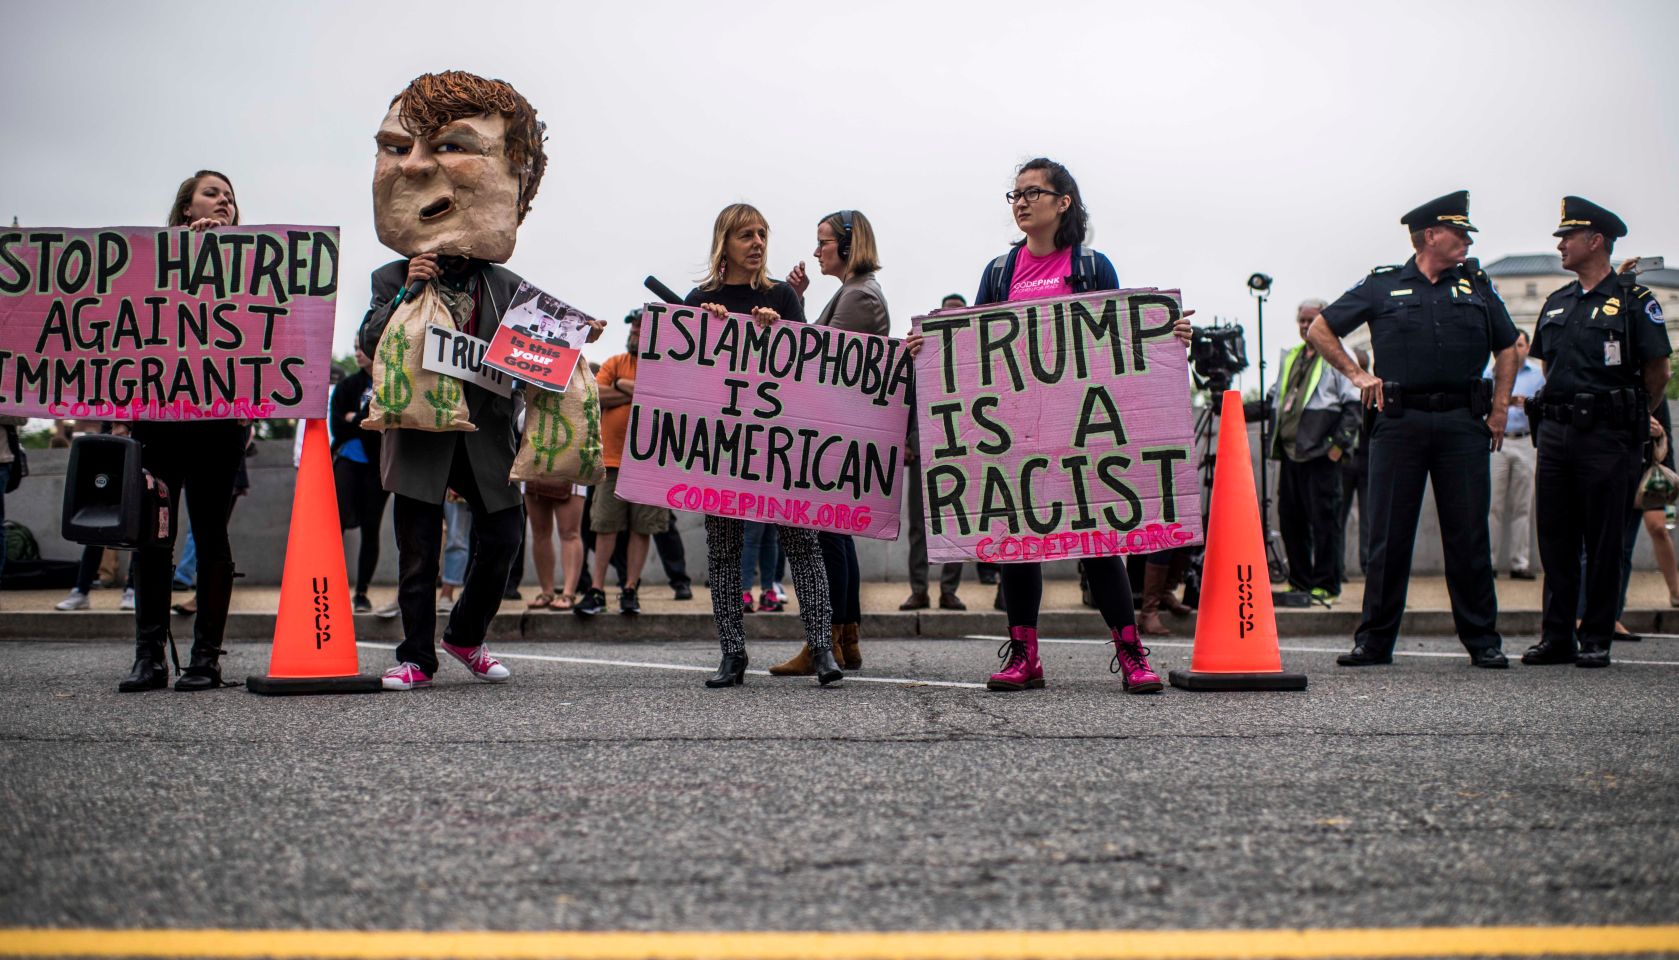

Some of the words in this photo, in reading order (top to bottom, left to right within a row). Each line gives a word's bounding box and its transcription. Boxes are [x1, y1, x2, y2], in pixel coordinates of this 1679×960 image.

[0, 231, 129, 295] STOP
[157, 230, 338, 304] HATRED
[1013, 277, 1060, 290] CODEPINK
[35, 297, 289, 354] AGAINST
[510, 335, 525, 349] Is
[528, 343, 561, 358] this
[921, 294, 1181, 393] TRUMP
[431, 327, 503, 384] TRU
[503, 356, 552, 376] GOP?
[510, 348, 554, 365] your
[641, 305, 914, 407] ISLAMOPHOBIA
[48, 397, 276, 421] CODEPINK.ORG
[721, 378, 783, 419] IS
[931, 396, 1011, 459] IS
[1074, 386, 1128, 448] A
[630, 405, 898, 500] UNAMERICAN
[666, 483, 872, 532] CODEPINK.ORG
[926, 449, 1187, 535] RACIST
[976, 522, 1194, 563] CODEPIN.ORG
[312, 576, 331, 650] USCP
[1237, 564, 1254, 639] USCP
